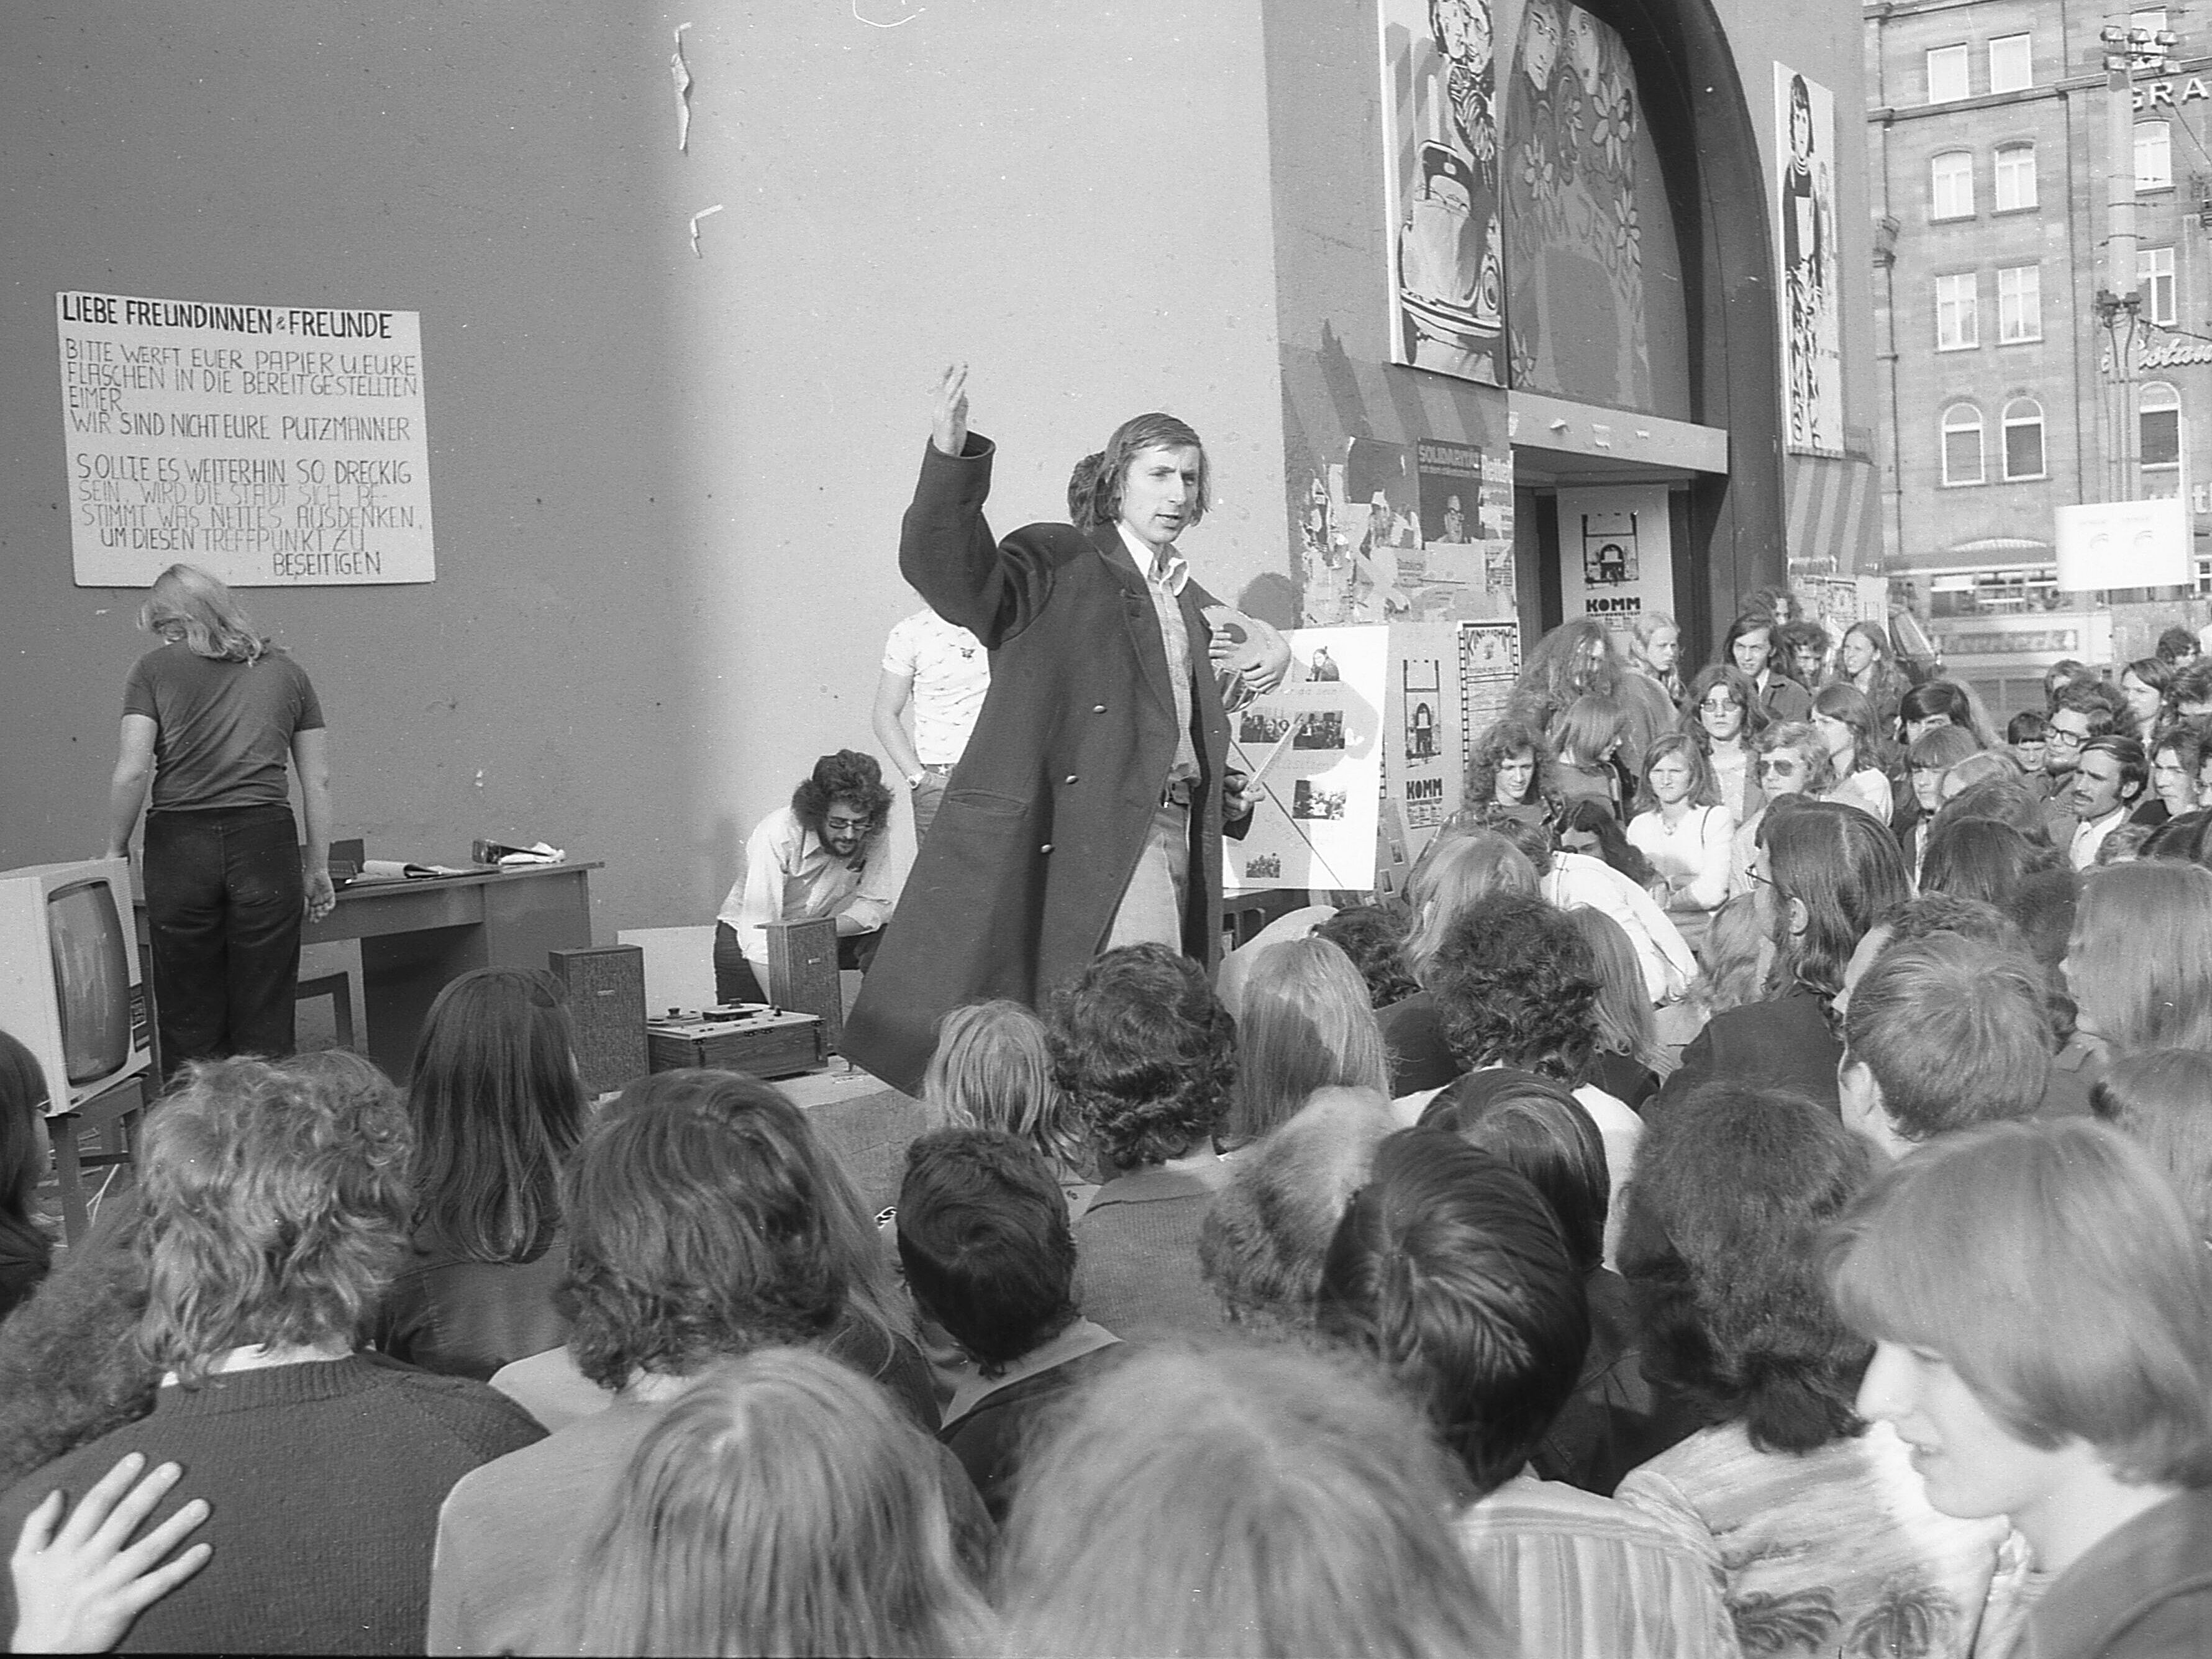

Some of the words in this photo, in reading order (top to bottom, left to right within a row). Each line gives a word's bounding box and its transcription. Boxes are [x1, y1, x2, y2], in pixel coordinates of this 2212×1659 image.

[63, 294, 117, 324] LIEBE
[126, 299, 272, 335] FREUNDINNEN
[289, 310, 393, 339] FREUNDE
[66, 338, 113, 362] BITTE
[121, 344, 181, 366] WERFT
[191, 347, 244, 370] EUER
[255, 350, 334, 374] PAPIER
[363, 355, 416, 376] EURE
[67, 361, 165, 389] FLASCHEN
[176, 368, 194, 391] IN
[203, 369, 233, 394] DIE
[70, 385, 122, 412] EIMER
[70, 409, 111, 434] WIR
[120, 412, 165, 435] SIND
[171, 412, 220, 438] NICHT
[223, 414, 270, 440] EURE
[77, 453, 150, 482] SOLLTE
[158, 457, 180, 483] ES
[184, 458, 286, 484] WEITERHIN
[296, 458, 325, 484] SO
[335, 460, 412, 484] DRECKIG
[139, 481, 187, 504] WIRD
[195, 481, 224, 506] DIE
[230, 483, 289, 506] STADT
[298, 483, 340, 509] SICH
[81, 503, 148, 527] STIMMT
[157, 504, 199, 529] WAS
[100, 527, 127, 547] UM
[132, 527, 194, 550] DIESEN
[201, 528, 326, 552] TREFFPUNKT
[332, 528, 364, 552] ZU
[272, 551, 381, 576] BESEITIGEN
[1586, 597, 1640, 612] KOMM
[1406, 778, 1442, 800] KOMM
